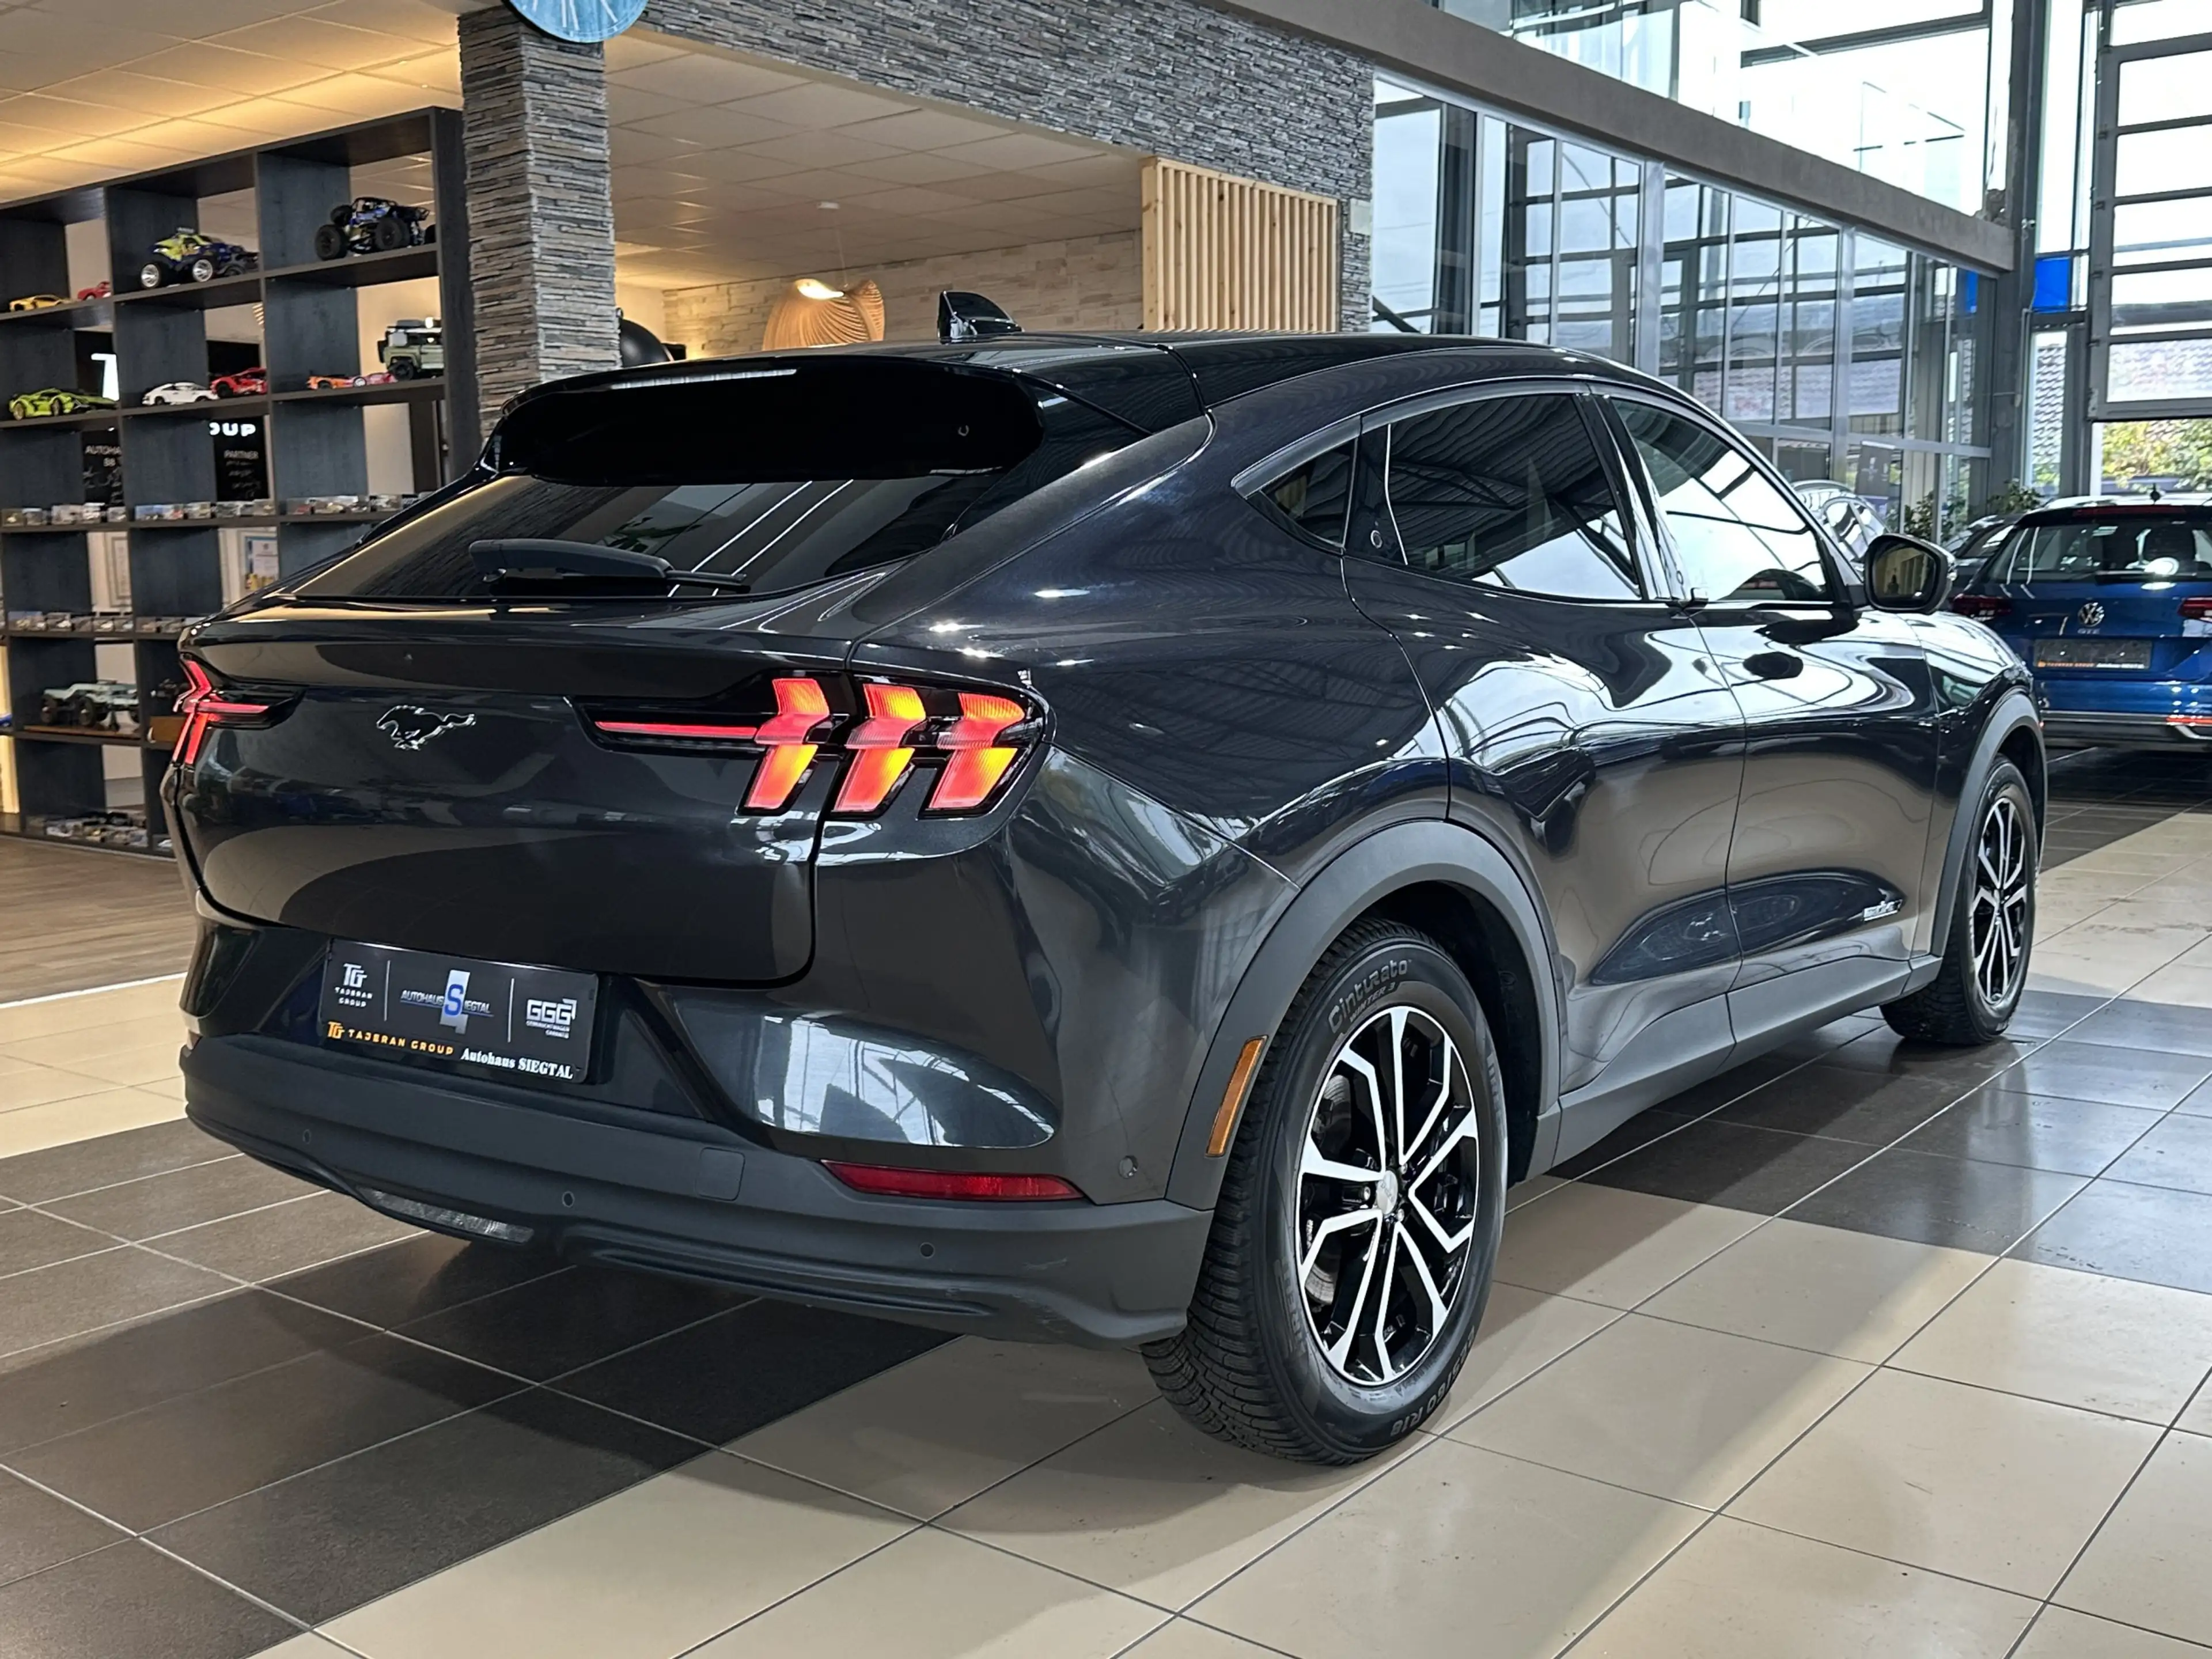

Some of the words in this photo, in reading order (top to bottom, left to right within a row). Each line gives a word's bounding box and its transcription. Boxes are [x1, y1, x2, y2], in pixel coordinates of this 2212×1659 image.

[338, 997, 367, 1008] GROUP
[400, 989, 445, 1006] AUTOHAUS
[1328, 959, 1407, 1034] Cinturato
[1349, 986, 1387, 1023] WINTER
[1388, 981, 1396, 991] 3
[347, 1028, 406, 1047] TAJERAN
[410, 1040, 454, 1055] GROUP
[460, 1048, 516, 1069] Autohaus
[517, 1057, 574, 1080] SIEGTAL
[1390, 1407, 1423, 1437] R18
